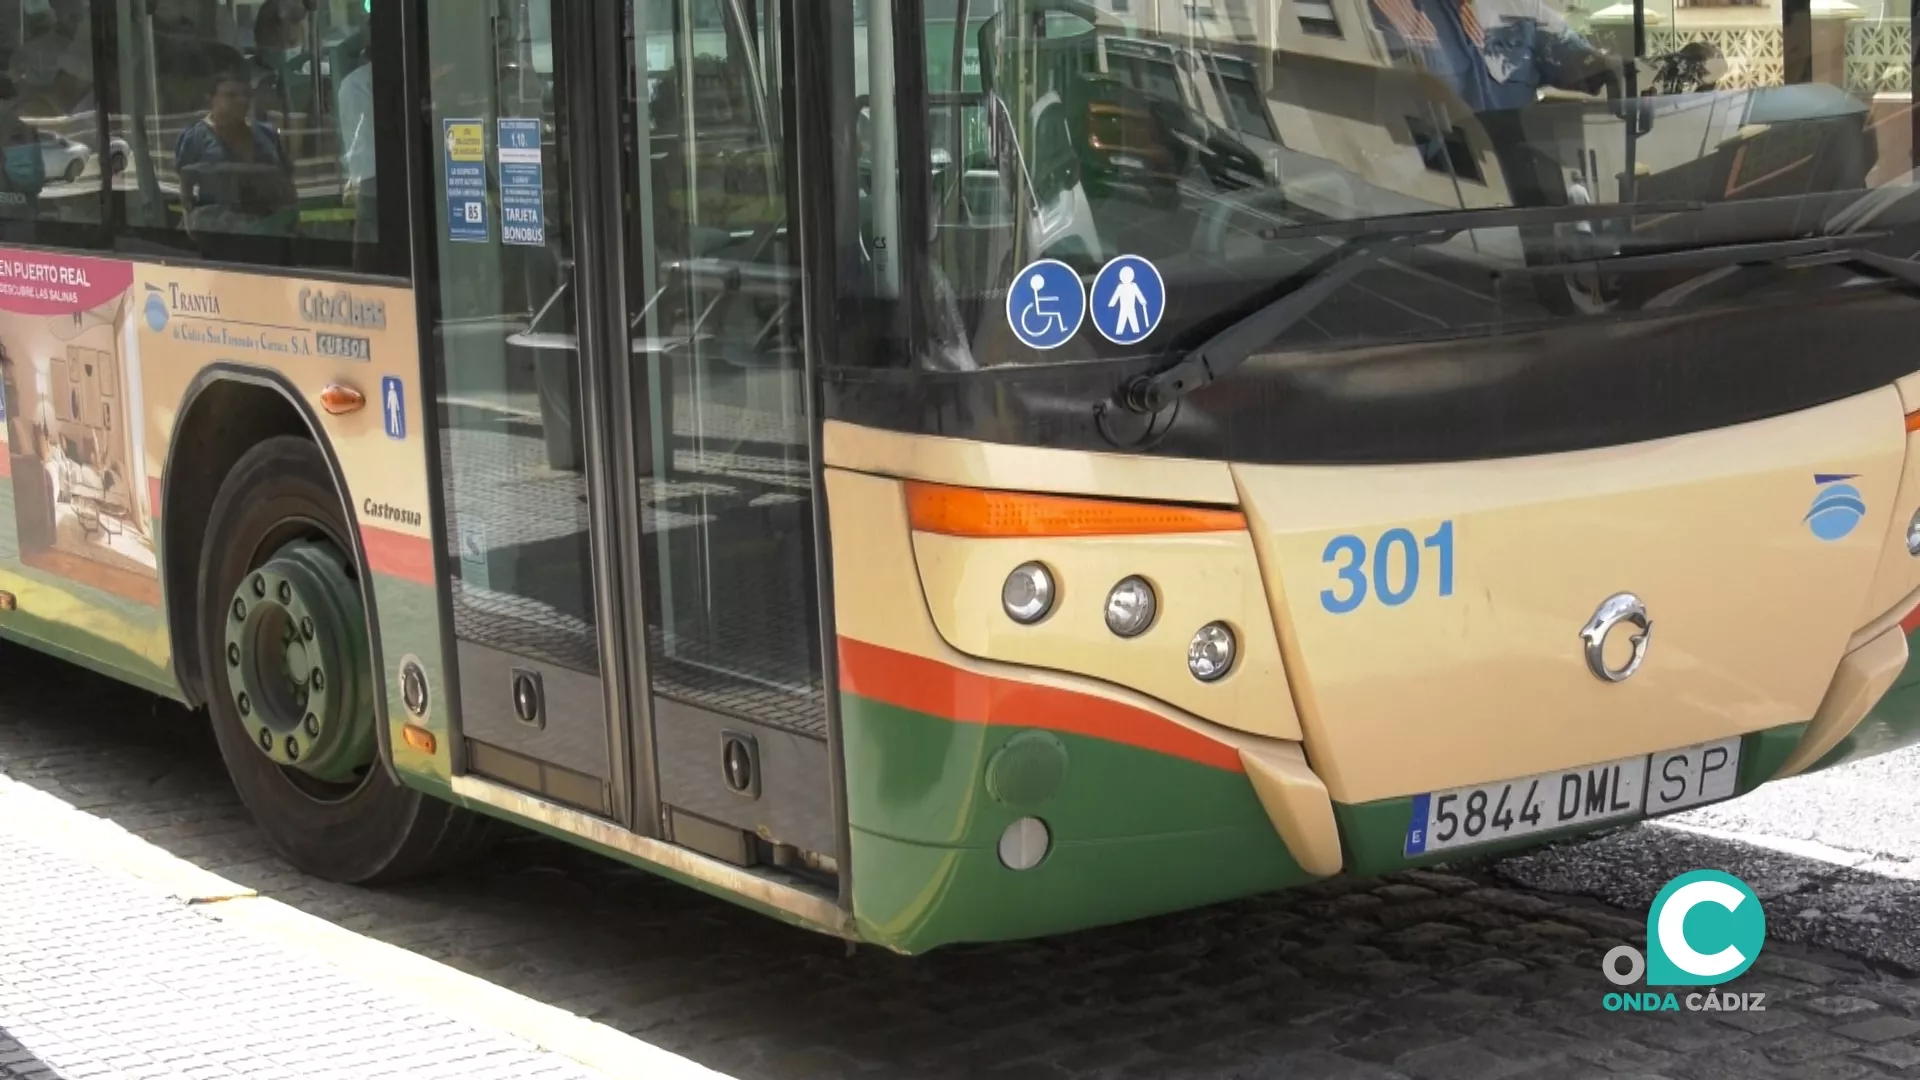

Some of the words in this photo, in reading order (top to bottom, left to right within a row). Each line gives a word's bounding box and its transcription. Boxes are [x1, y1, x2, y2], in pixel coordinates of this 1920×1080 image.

[467, 205, 479, 220] 85
[504, 207, 538, 223] TARJETA
[503, 225, 543, 241] BONOBÚS
[14, 262, 58, 283] PUERTO
[60, 266, 91, 287] REAL
[36, 287, 48, 300] LAS
[50, 290, 78, 303] SALINAS
[318, 333, 369, 360] CURSOR
[363, 498, 422, 527] Castrosua
[1320, 520, 1454, 614] 301
[1436, 780, 1542, 841] 5844
[1558, 765, 1630, 821] DML
[1412, 830, 1421, 843] E
